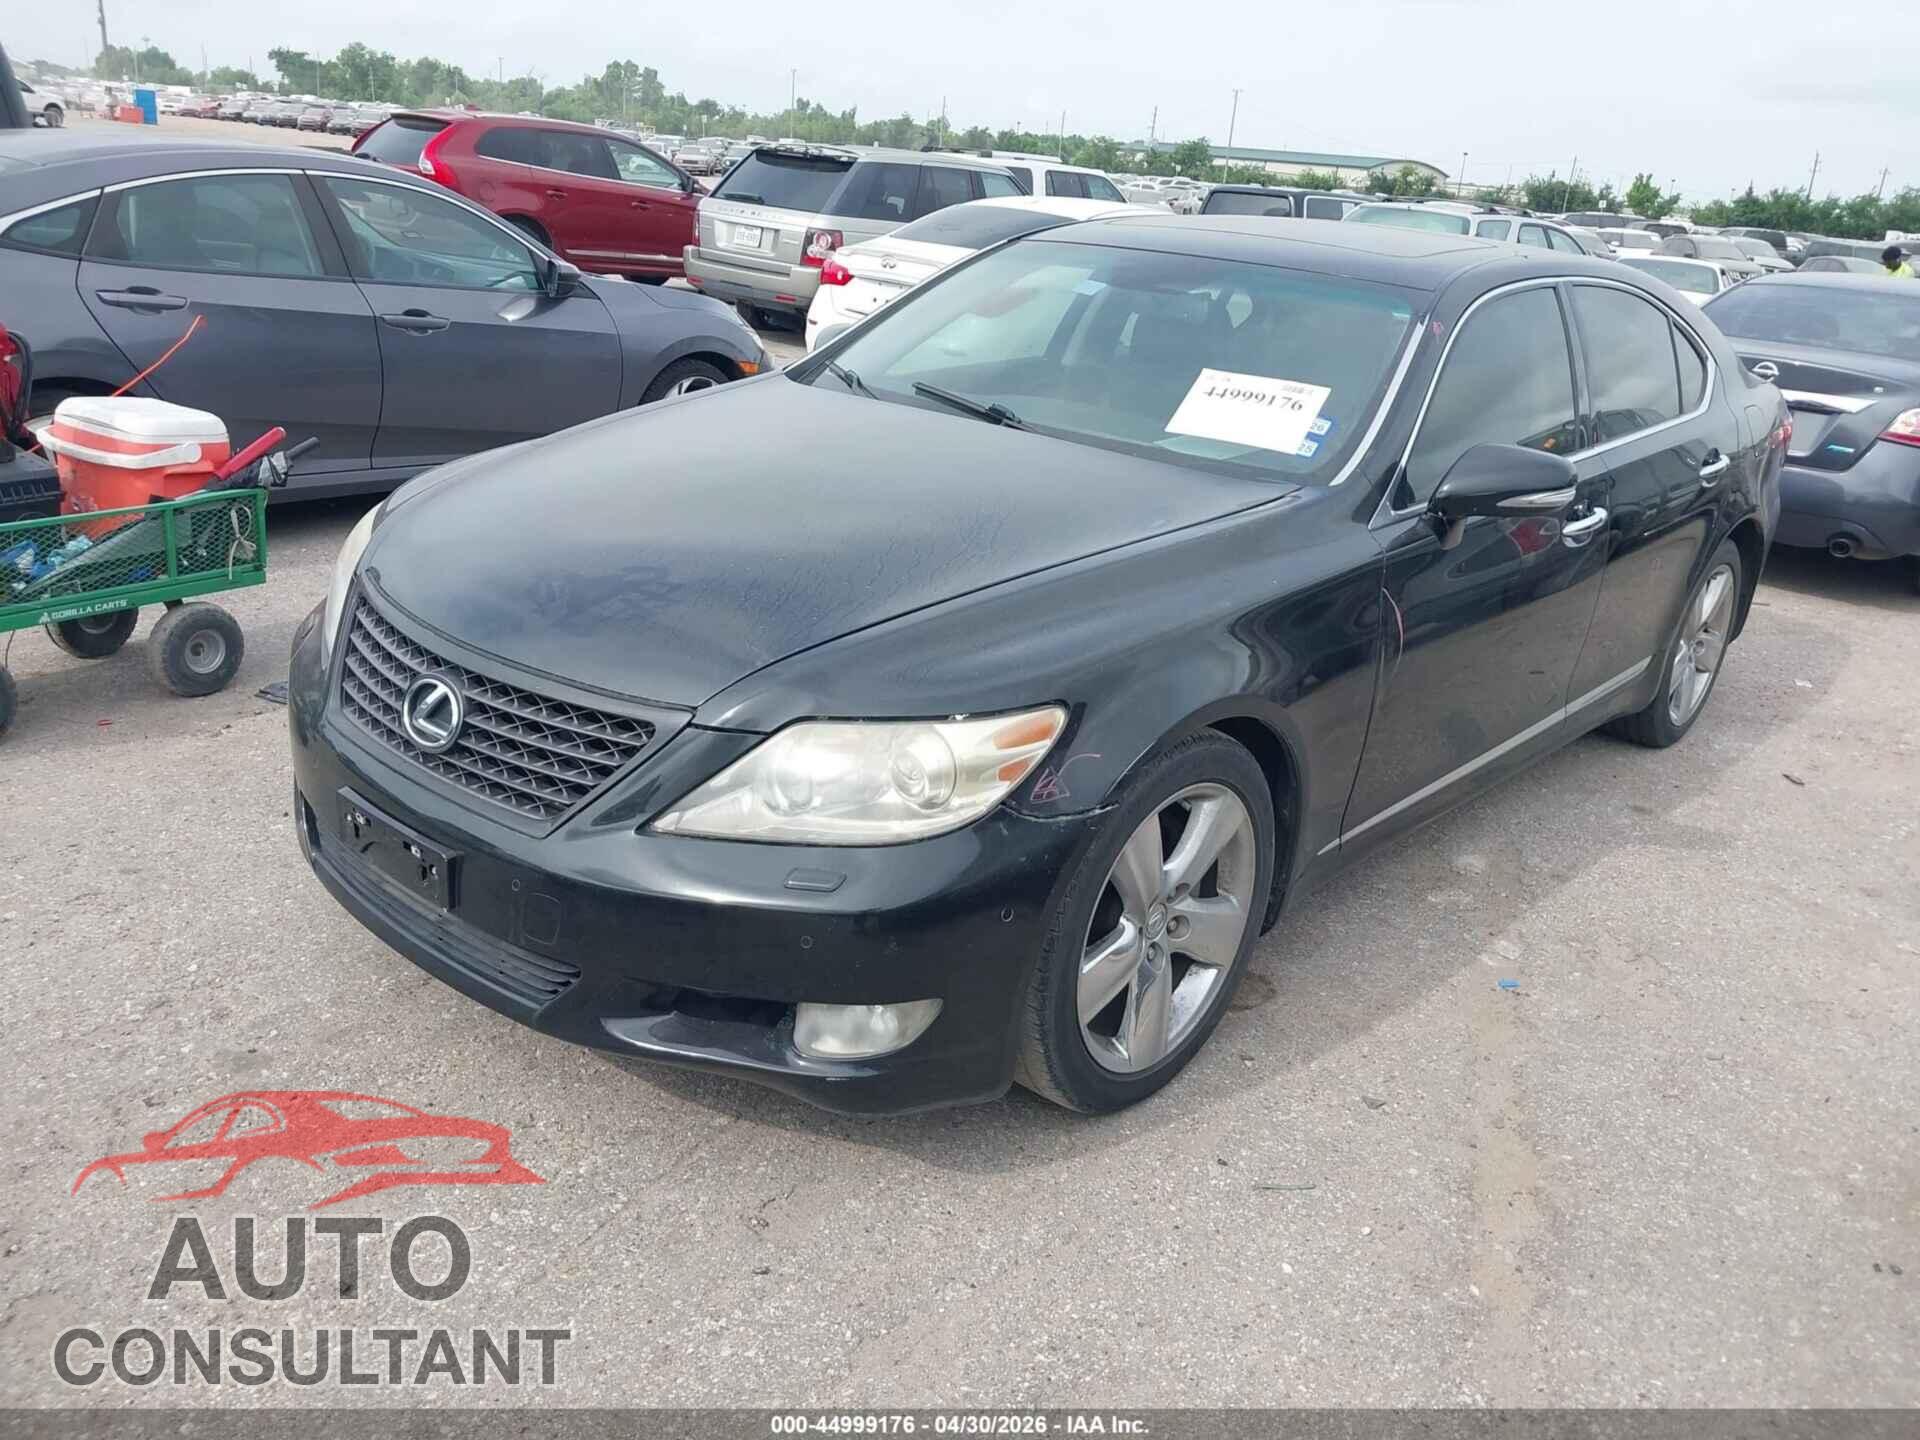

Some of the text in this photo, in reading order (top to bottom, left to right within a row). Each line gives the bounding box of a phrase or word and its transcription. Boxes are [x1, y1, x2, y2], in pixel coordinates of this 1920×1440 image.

[1202, 386, 1304, 410] 44999176
[51, 600, 128, 619] GORILLA CARTS
